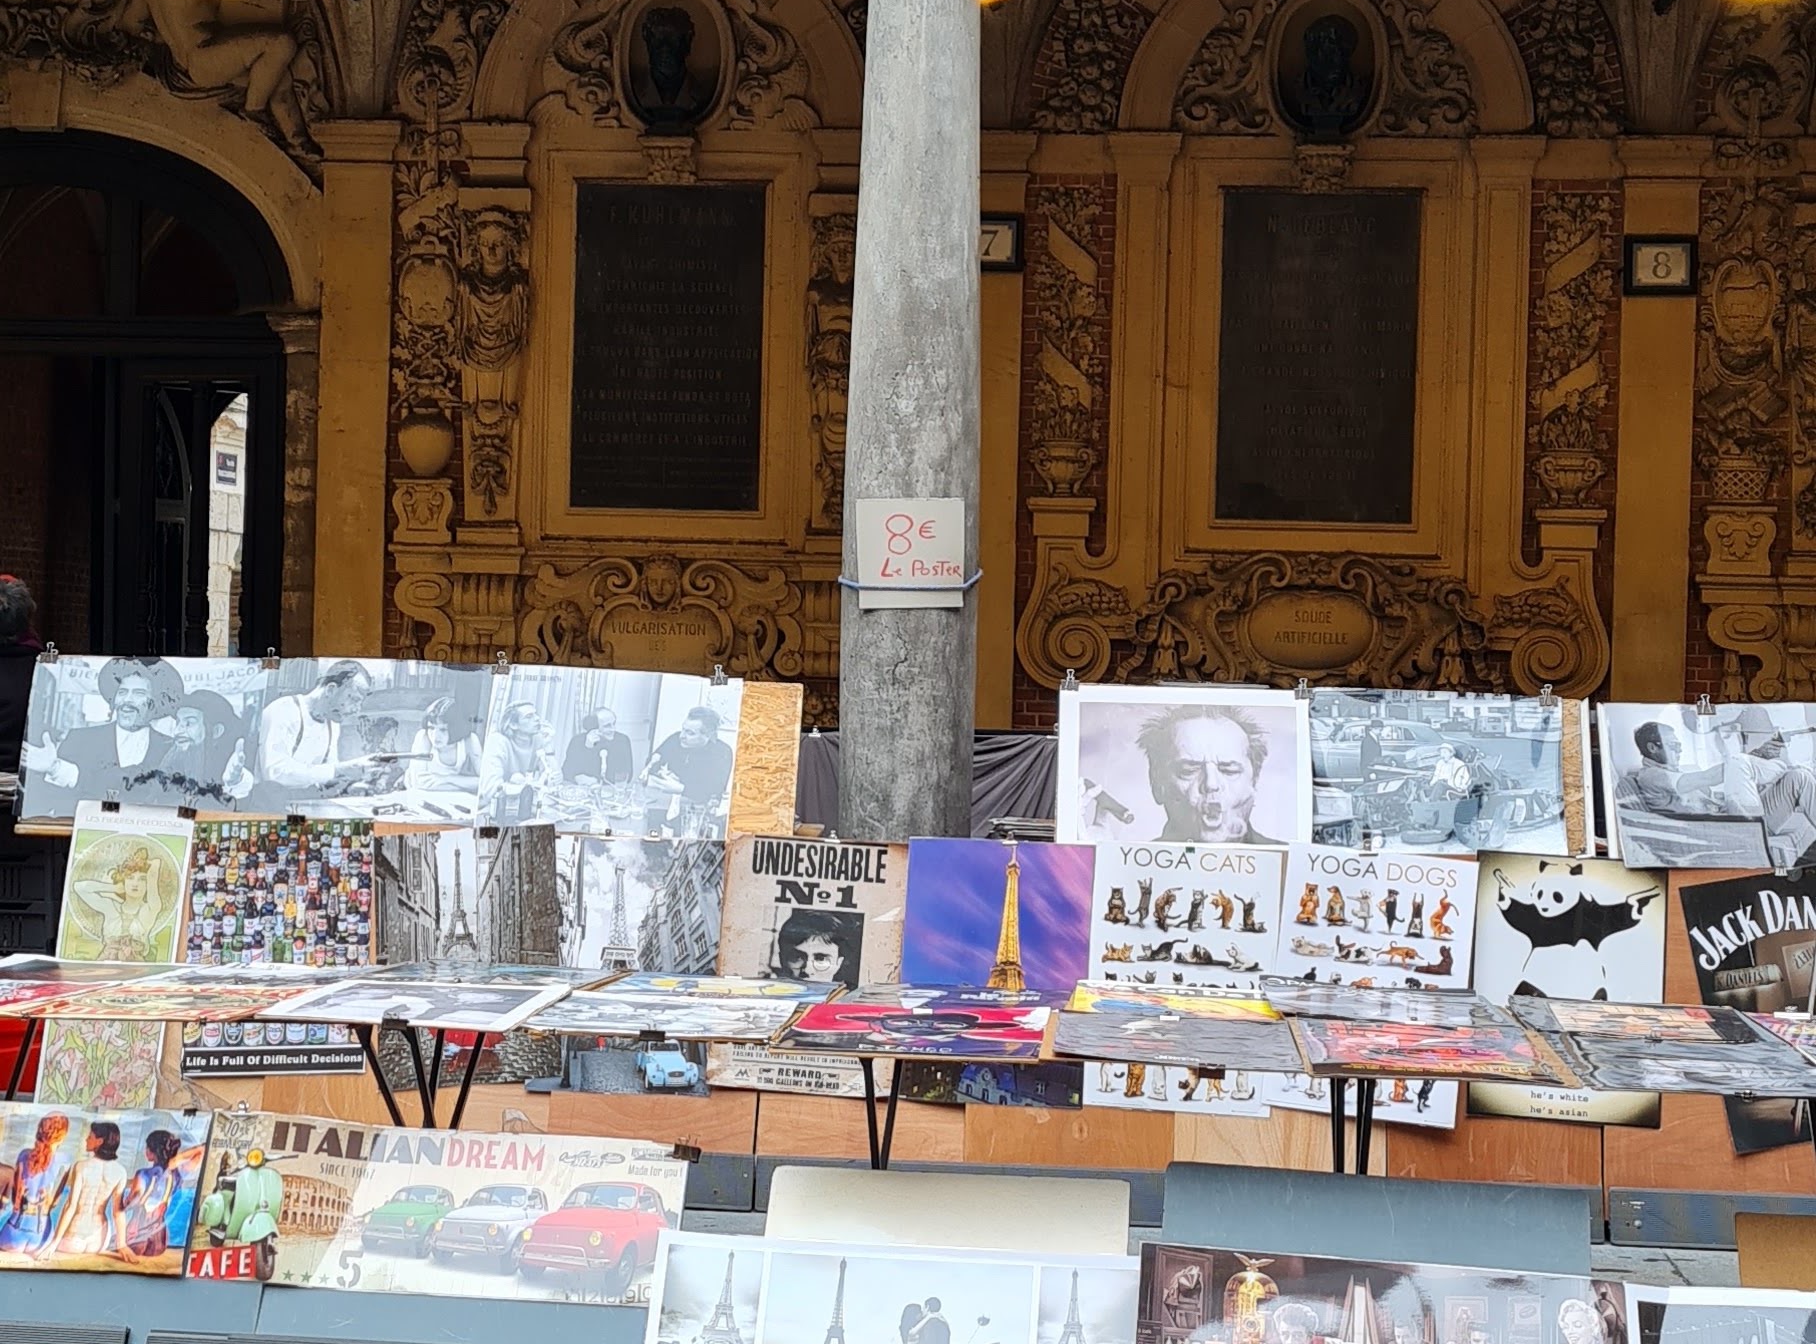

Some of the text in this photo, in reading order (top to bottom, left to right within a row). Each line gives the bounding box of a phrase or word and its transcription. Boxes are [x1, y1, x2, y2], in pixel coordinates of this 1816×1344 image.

[982, 229, 999, 257] 7
[1652, 251, 1672, 279] 8
[1294, 610, 1333, 625] SOUDE
[611, 621, 706, 637] VULGARISATION
[1274, 631, 1349, 646] ARTIFICIELLE
[752, 840, 888, 884] UNDESIRABLE
[1120, 845, 1256, 875] YOGA CATS
[1308, 852, 1458, 888] YOGA DOGS
[1689, 905, 1766, 971] JACK
[185, 1053, 362, 1066] Life Is Full Of Difficult Decisions
[777, 1067, 822, 1080] REWARD
[1530, 1090, 1589, 1103] he's white
[1530, 1105, 1589, 1118] he's asian
[319, 1162, 345, 1177] SINCE
[628, 1164, 648, 1176] Made
[650, 1166, 661, 1176] for
[663, 1169, 678, 1178] you
[336, 1250, 365, 1289] 5
